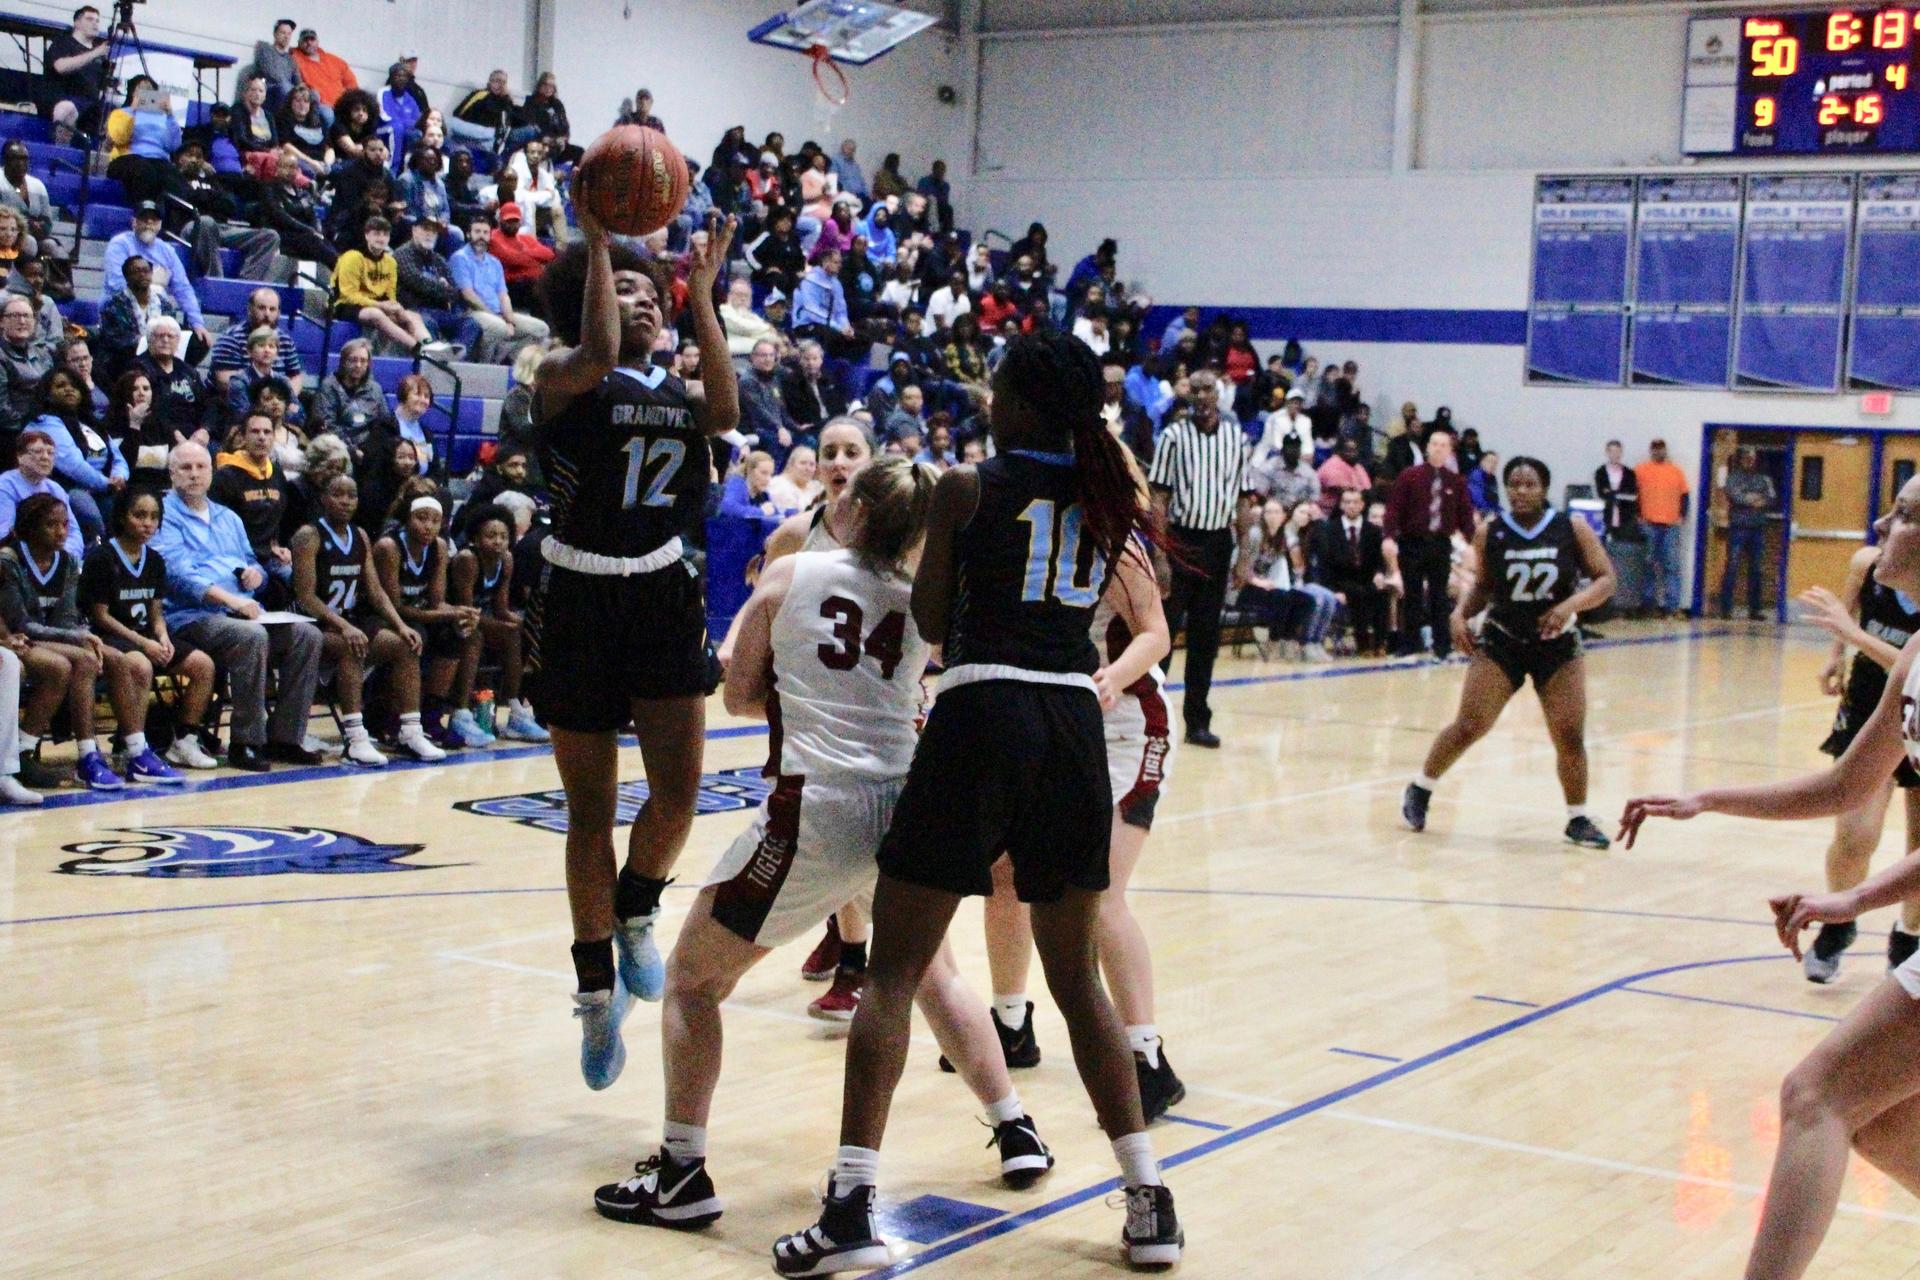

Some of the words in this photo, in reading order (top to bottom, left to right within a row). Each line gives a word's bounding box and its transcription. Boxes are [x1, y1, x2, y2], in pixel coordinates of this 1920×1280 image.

[1826, 13, 1907, 51] 6:13
[1751, 38, 1798, 76] 50
[1885, 65, 1908, 90] 4
[1754, 98, 1776, 127] 9
[620, 436, 687, 510] 12
[1016, 498, 1108, 608] 10
[1506, 562, 1559, 601] 22
[818, 595, 907, 680] 34
